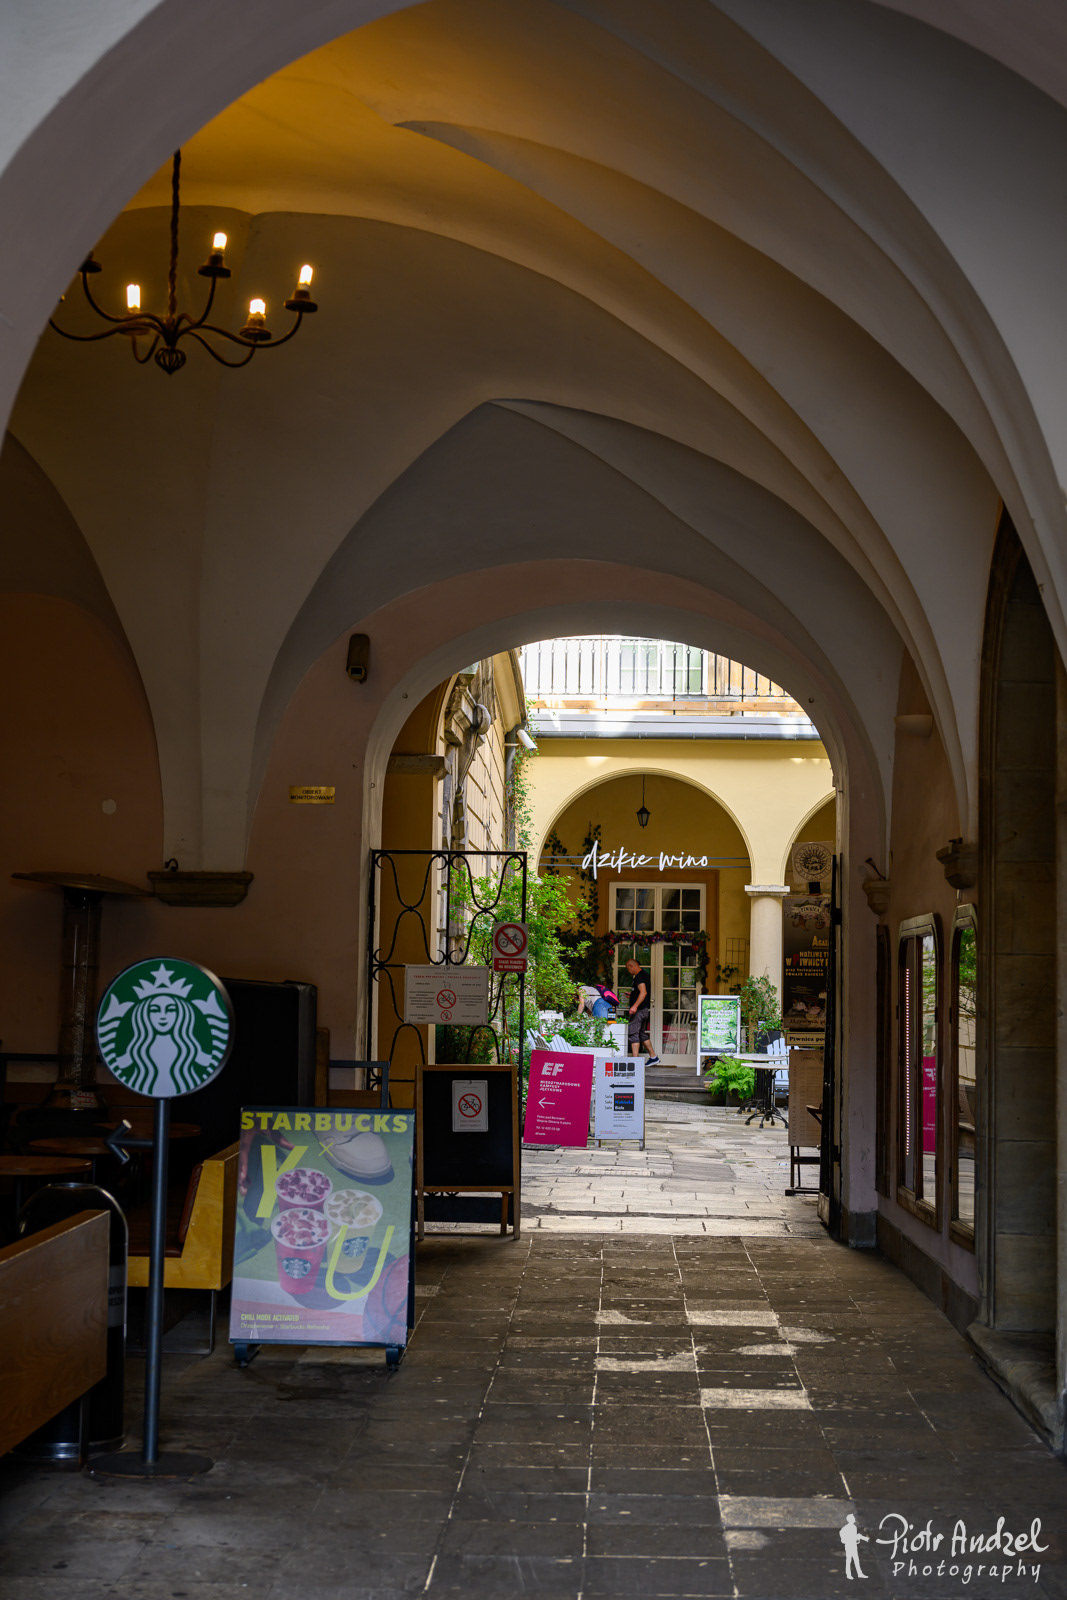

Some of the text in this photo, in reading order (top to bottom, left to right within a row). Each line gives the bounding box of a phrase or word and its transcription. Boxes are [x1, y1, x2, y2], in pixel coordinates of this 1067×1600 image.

[581, 839, 708, 880] dzikie wino
[785, 957, 793, 967] W
[541, 1062, 565, 1076] EF
[241, 1111, 408, 1133] STARBUCKS
[240, 1313, 300, 1322] CHILL MODE ACTIVATED
